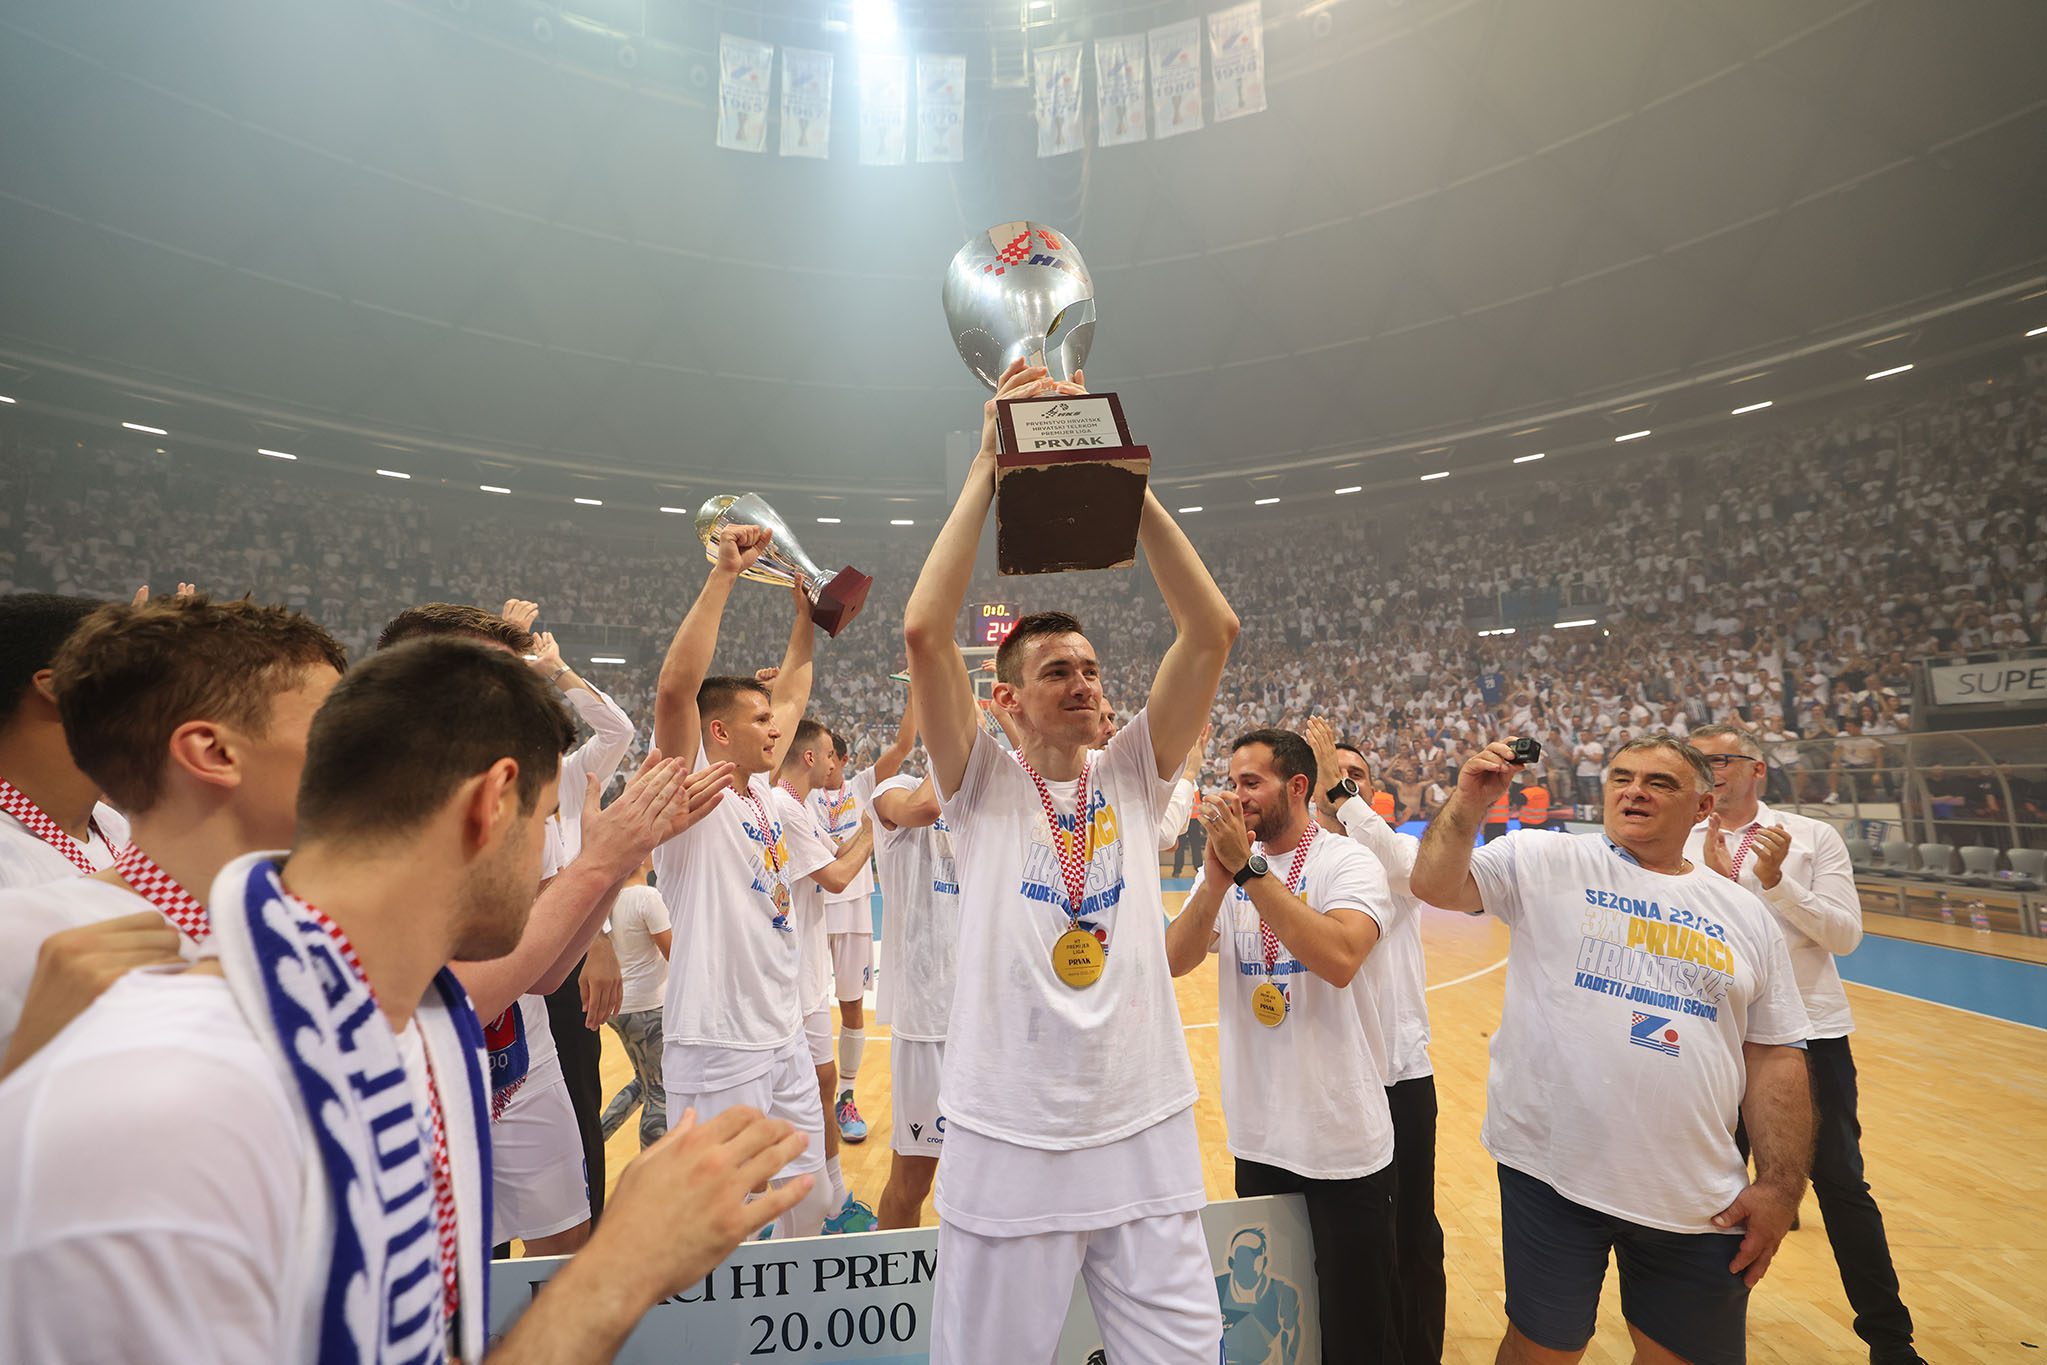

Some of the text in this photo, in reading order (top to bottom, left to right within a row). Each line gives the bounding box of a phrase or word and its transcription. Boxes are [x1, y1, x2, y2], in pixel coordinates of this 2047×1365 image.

[1034, 436, 1104, 449] PRVAK
[1585, 888, 1662, 921] SEZONA
[1068, 957, 1091, 966] PRVAK
[1627, 916, 1735, 977] PRVACI
[1576, 936, 1735, 1005] HRVATSKE
[730, 1261, 799, 1300] HT
[749, 1301, 917, 1356] 20.000
